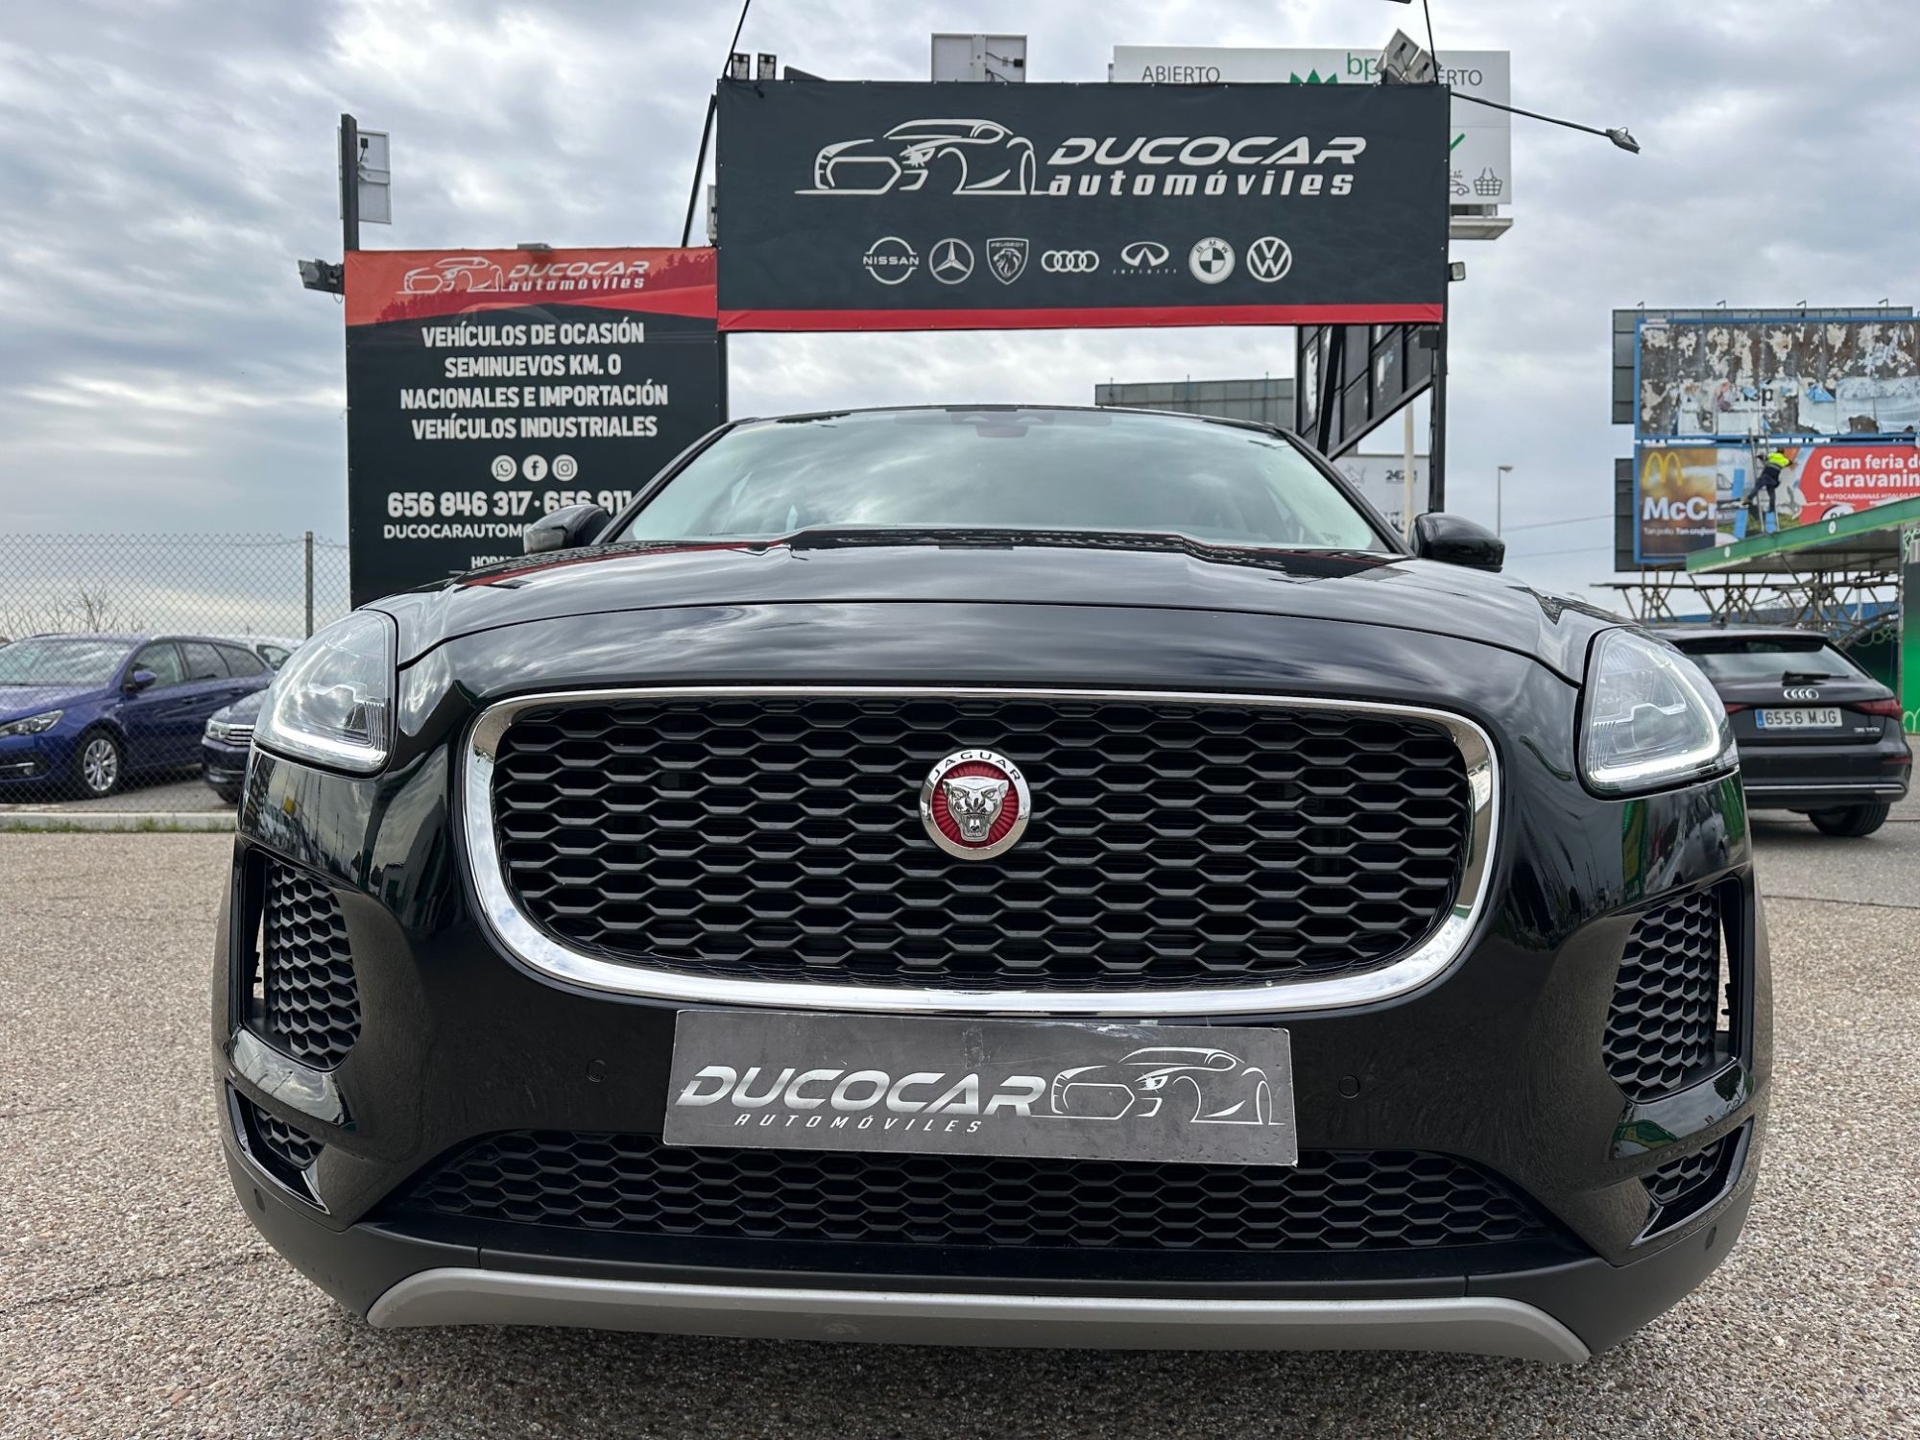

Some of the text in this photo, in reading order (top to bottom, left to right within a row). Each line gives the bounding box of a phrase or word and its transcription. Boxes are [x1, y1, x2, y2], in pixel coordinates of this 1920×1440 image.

[1142, 65, 1221, 83] ABIERTO
[1347, 51, 1378, 81] bp
[1046, 136, 1367, 166] DUCOCAR
[1049, 169, 1354, 196] automóviles
[508, 260, 650, 278] DUCOCAR
[862, 255, 919, 266] NISSAN
[421, 316, 645, 348] VEHÍCULOS DE OCASIÓN
[444, 355, 566, 378] SEMINUEVOS
[569, 354, 605, 375] KM.
[400, 379, 669, 409] NACIONALES E IMPORTACIÓN
[411, 413, 658, 440] VEHÍCULOS INDUSTRIALES
[1820, 453, 1920, 470] Gran feria d
[387, 491, 435, 518] 656
[440, 490, 488, 517] 846
[1764, 710, 1838, 726] 6556 MJG
[933, 751, 1022, 781] JAGUAR
[675, 1065, 1048, 1117] DUCOCAR
[734, 1112, 984, 1133] AUTOMÓVILES
